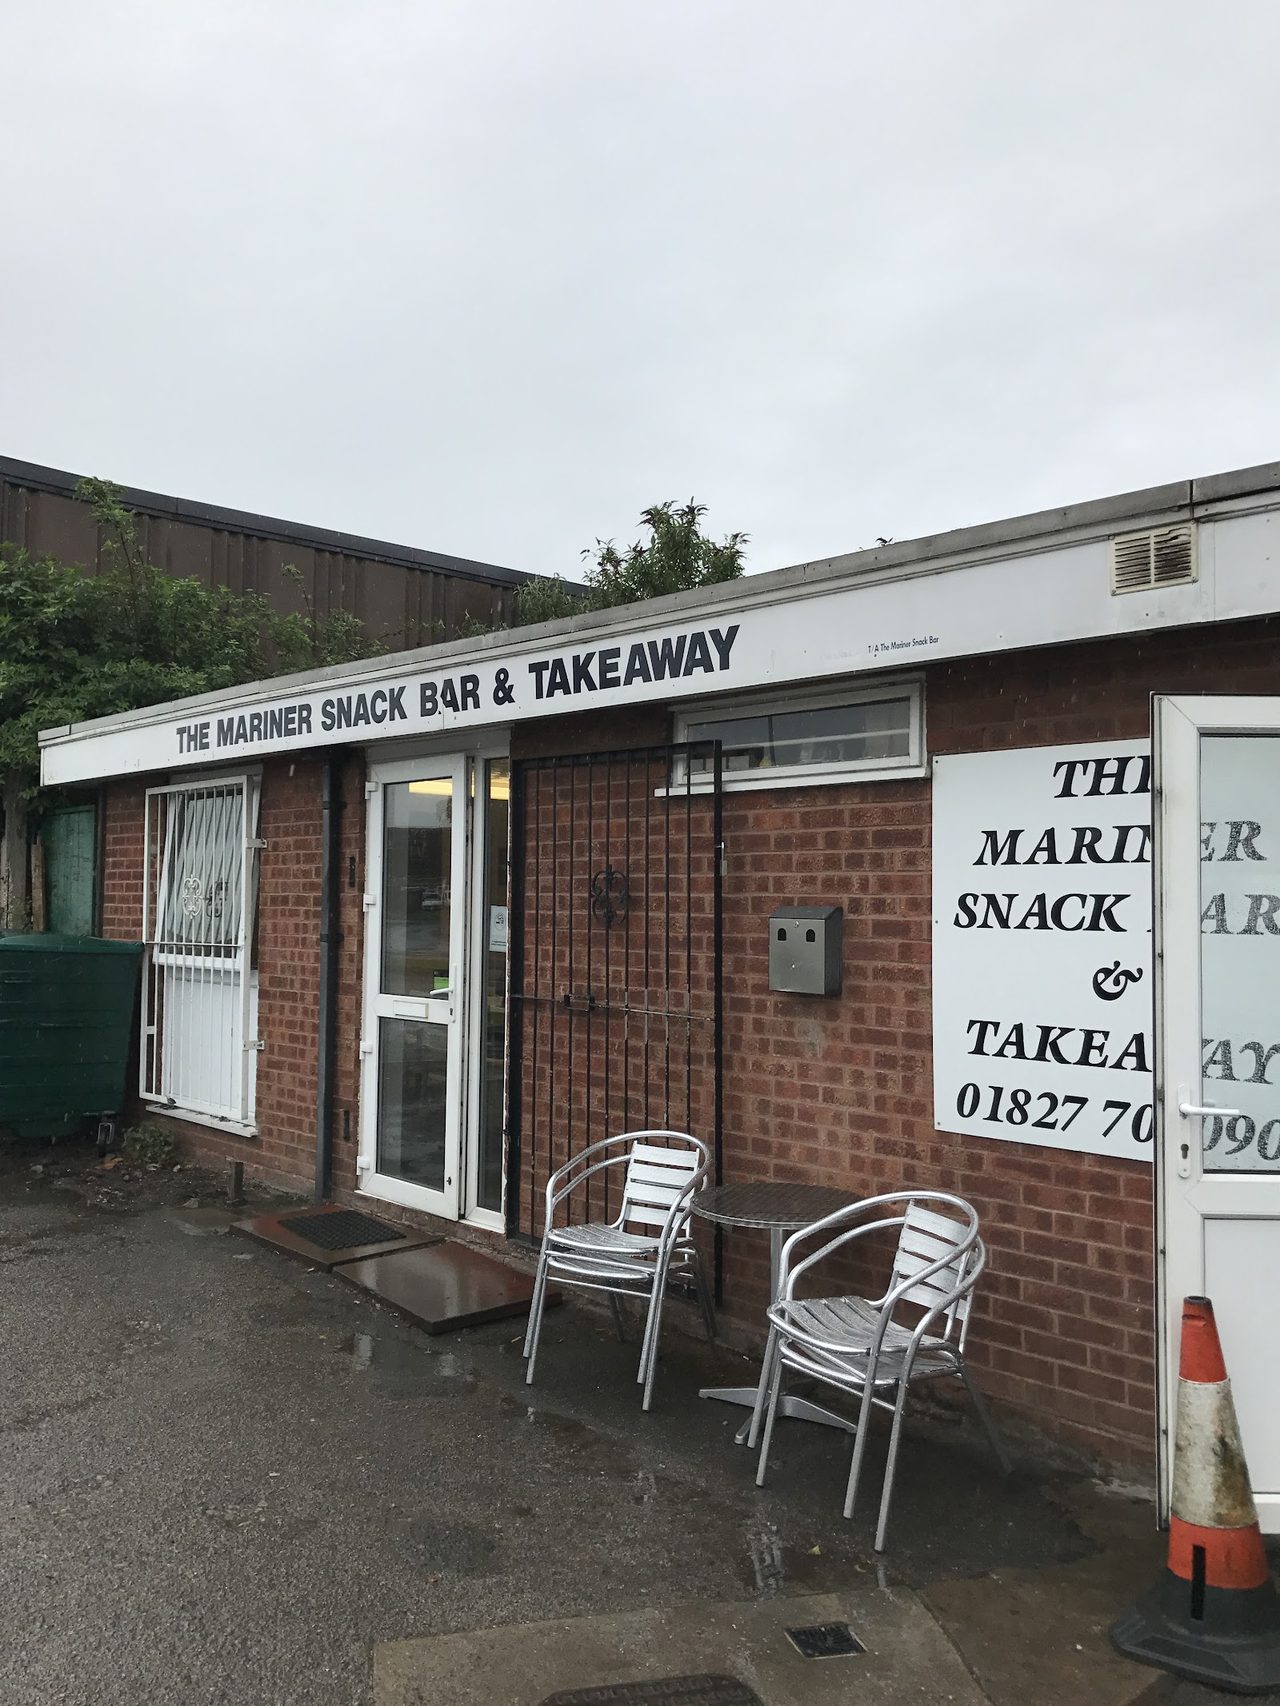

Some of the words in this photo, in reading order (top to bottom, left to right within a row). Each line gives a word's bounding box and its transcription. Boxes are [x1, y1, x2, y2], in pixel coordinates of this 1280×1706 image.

[880, 643, 890, 652] The
[890, 641, 911, 650] Mariner
[912, 636, 928, 647] Snack
[928, 635, 939, 644] Bar
[176, 722, 210, 755] THE
[216, 703, 313, 748] MARINER
[320, 686, 407, 732] SNACK
[419, 674, 480, 718] BAR
[493, 667, 515, 706] &
[528, 624, 741, 699] TAKEAWAY
[953, 892, 1131, 933] SNACK
[1092, 960, 1143, 1001] &
[957, 1082, 1089, 1132] 01827
